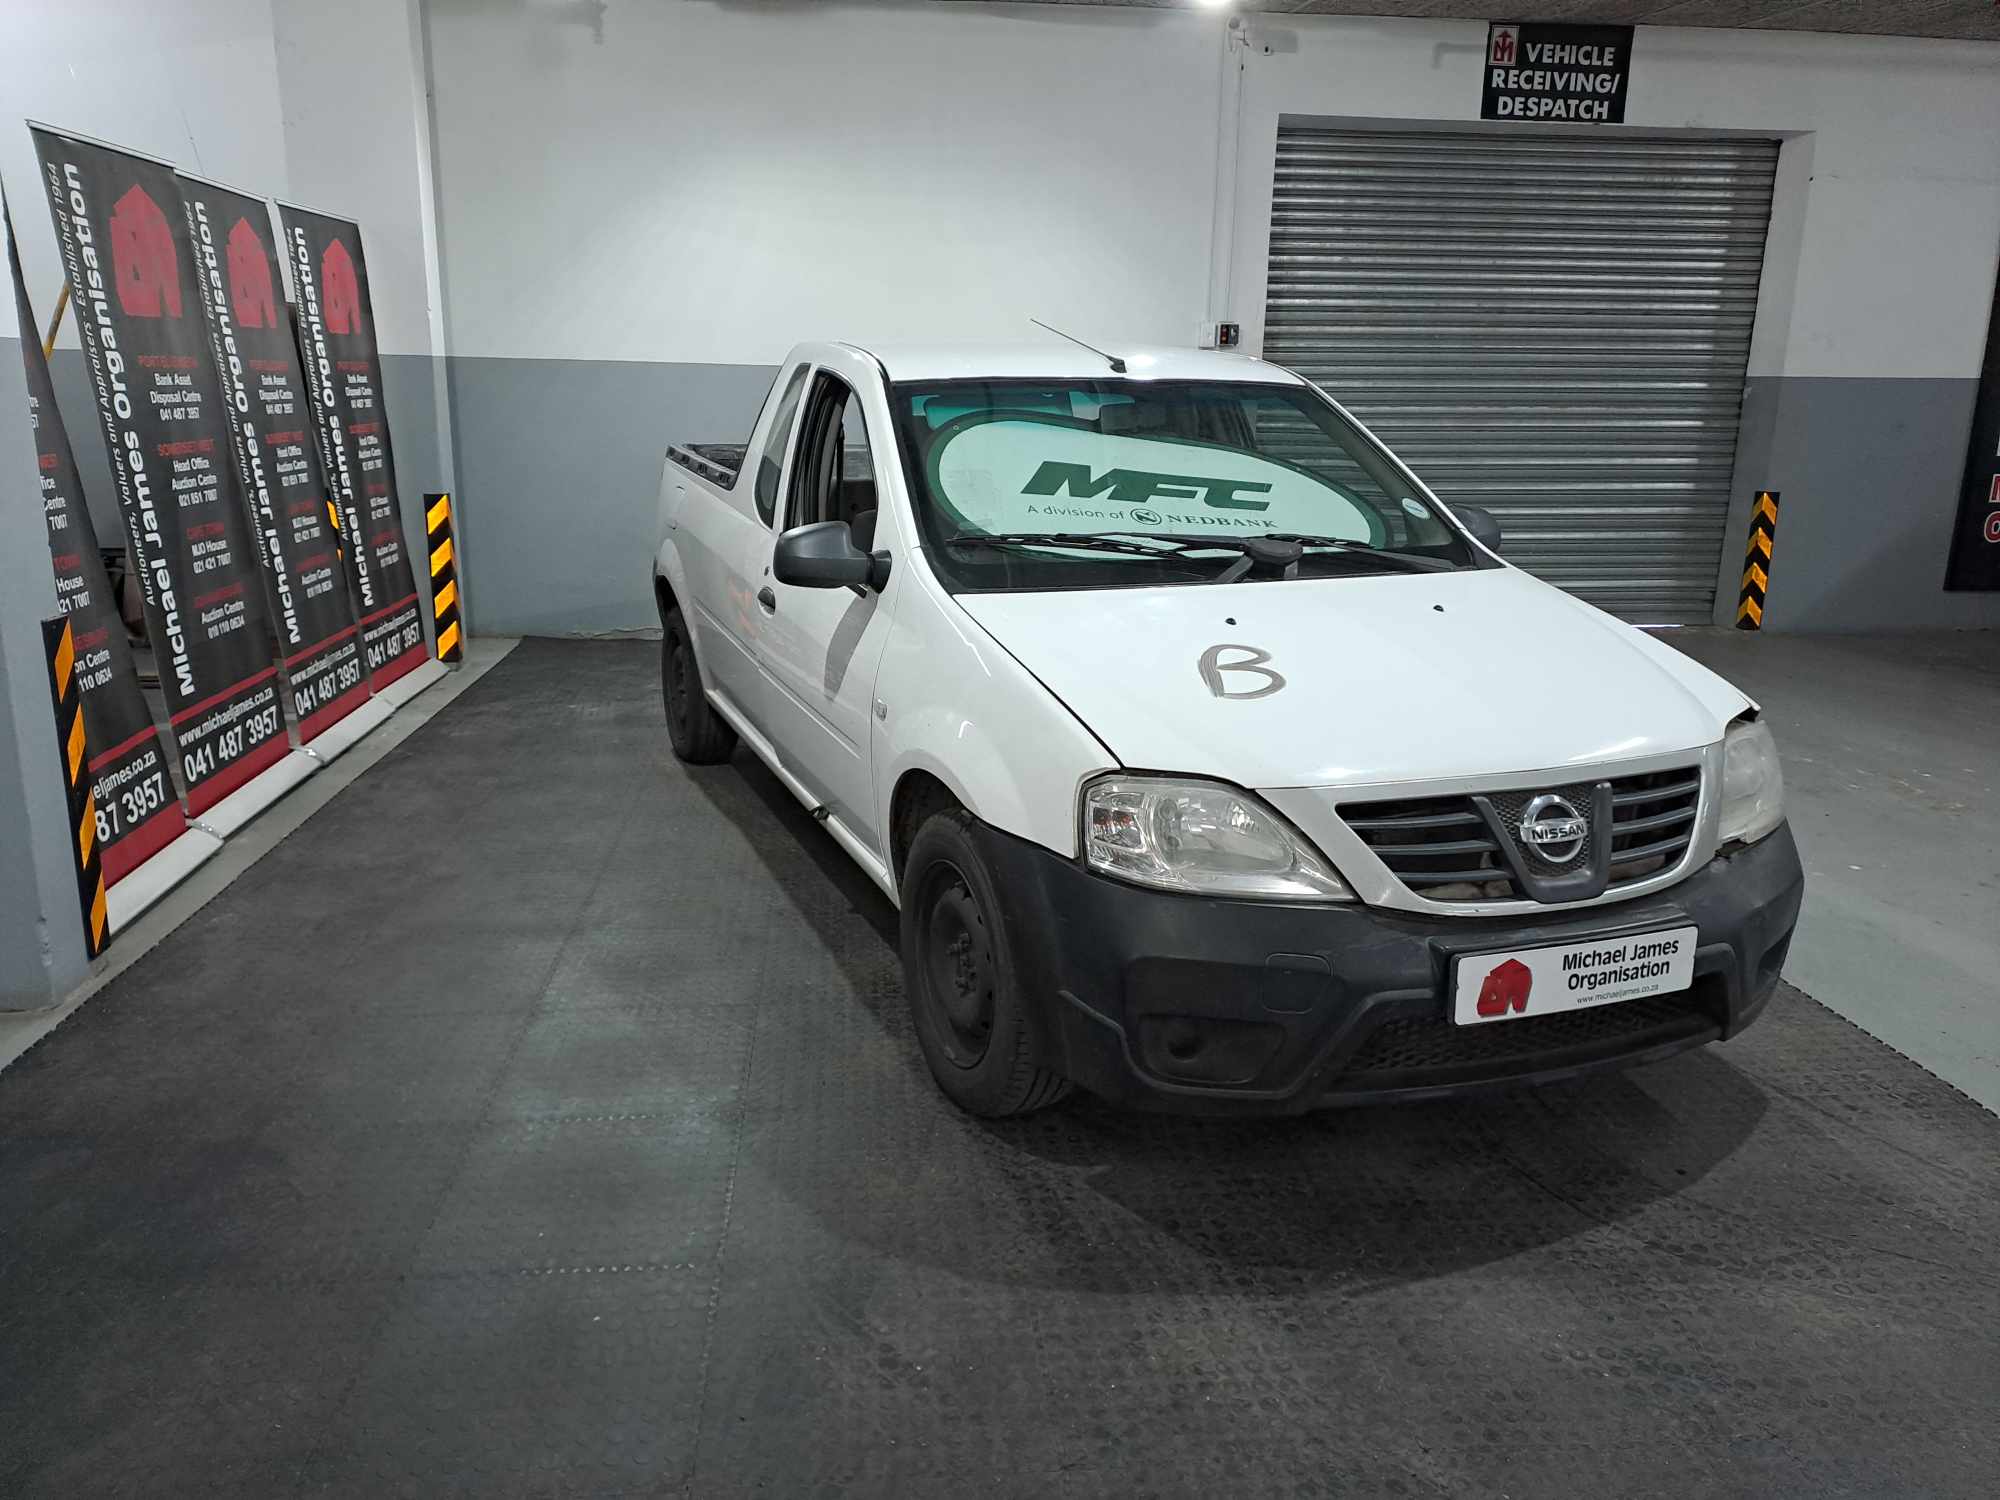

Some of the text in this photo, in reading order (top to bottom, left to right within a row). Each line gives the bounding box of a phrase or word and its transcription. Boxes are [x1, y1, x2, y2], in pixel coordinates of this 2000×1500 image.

[1525, 43, 1616, 66] VEHICLE
[1491, 68, 1621, 94] RECEIVING/
[1497, 95, 1609, 119] DESPATCH
[195, 201, 248, 413] Organisation
[212, 332, 233, 403] Appraisers
[47, 162, 155, 606] Auctioneers, Valuers and Appraisers Established 1964
[150, 390, 182, 405] Disposal
[159, 408, 173, 421] 041
[173, 408, 186, 420] 487
[227, 406, 240, 432] and
[294, 227, 374, 607] Michael James Organisation
[313, 401, 325, 424] and
[63, 163, 195, 697] Michael James Organisation
[171, 477, 197, 491] Auction
[243, 422, 273, 520] James
[1020, 460, 1273, 511] MFC
[49, 514, 68, 530] 7007
[1027, 504, 1279, 528] A division of NEDBANK
[206, 540, 227, 553] House
[56, 576, 84, 593] House
[264, 528, 301, 644] Michael
[72, 591, 90, 609] 7007
[201, 608, 225, 624] Auction
[86, 649, 110, 667] Centre
[367, 621, 420, 669] 041 487 3957
[78, 673, 94, 692] 110
[1197, 644, 1287, 699] B
[295, 658, 361, 716] 041 487 3957
[178, 687, 274, 747] www.michaeljames.co.za
[184, 704, 278, 783] 041 487 3957
[122, 771, 165, 824] 3957
[1531, 823, 1584, 840] NISSAN
[1562, 939, 1679, 971] Michael James
[1568, 959, 1670, 991] Organisation
